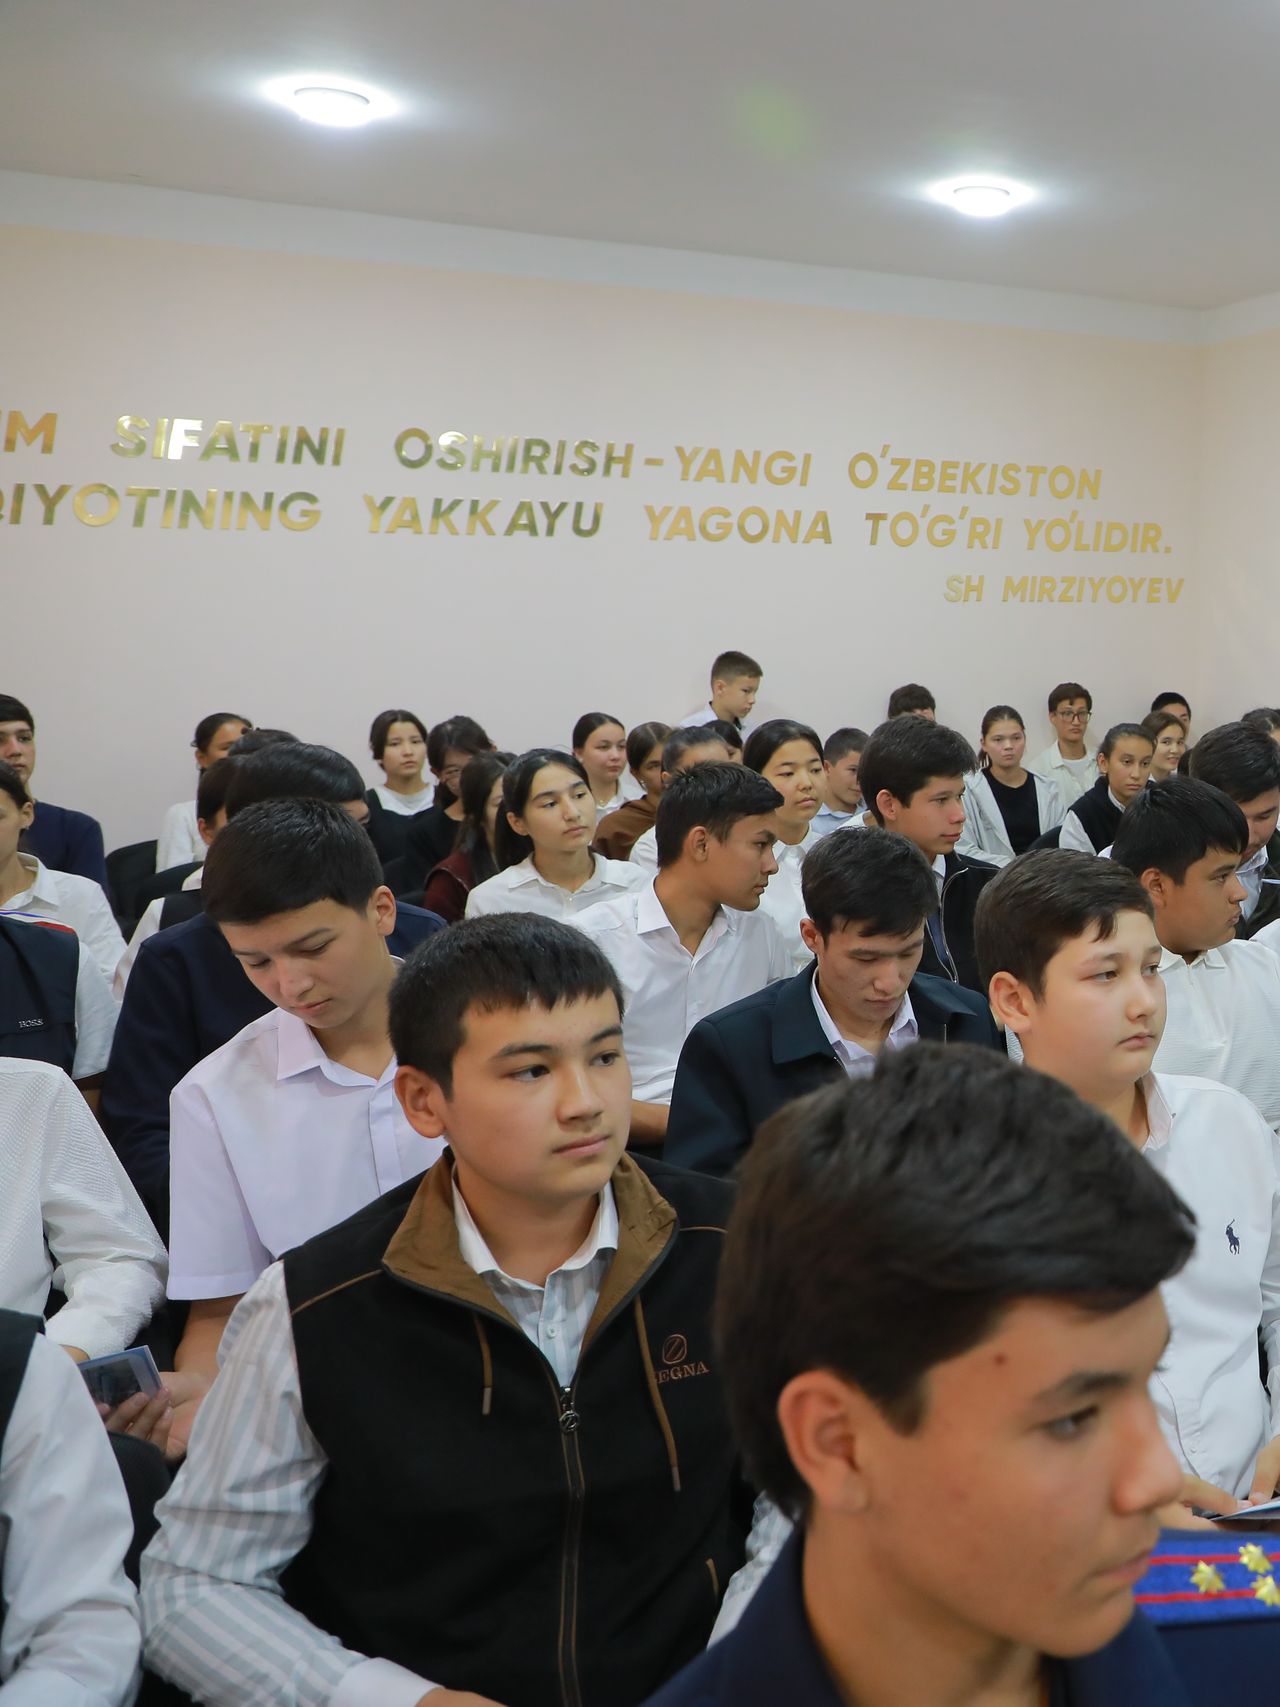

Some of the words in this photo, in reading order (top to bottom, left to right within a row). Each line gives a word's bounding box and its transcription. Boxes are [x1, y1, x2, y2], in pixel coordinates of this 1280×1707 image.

[0, 409, 59, 455] M
[110, 414, 347, 468] SIFATINI
[847, 444, 1102, 501] O'ZBEKISTON
[0, 482, 322, 533] IYOTINING
[363, 494, 604, 539] YAKKAYU
[644, 504, 833, 545] YAGONA
[864, 503, 1003, 550] TO'G'RI
[943, 575, 985, 604] SH
[1001, 575, 1185, 604] MIRZIYOYEV
[655, 1361, 710, 1384] EGNA
